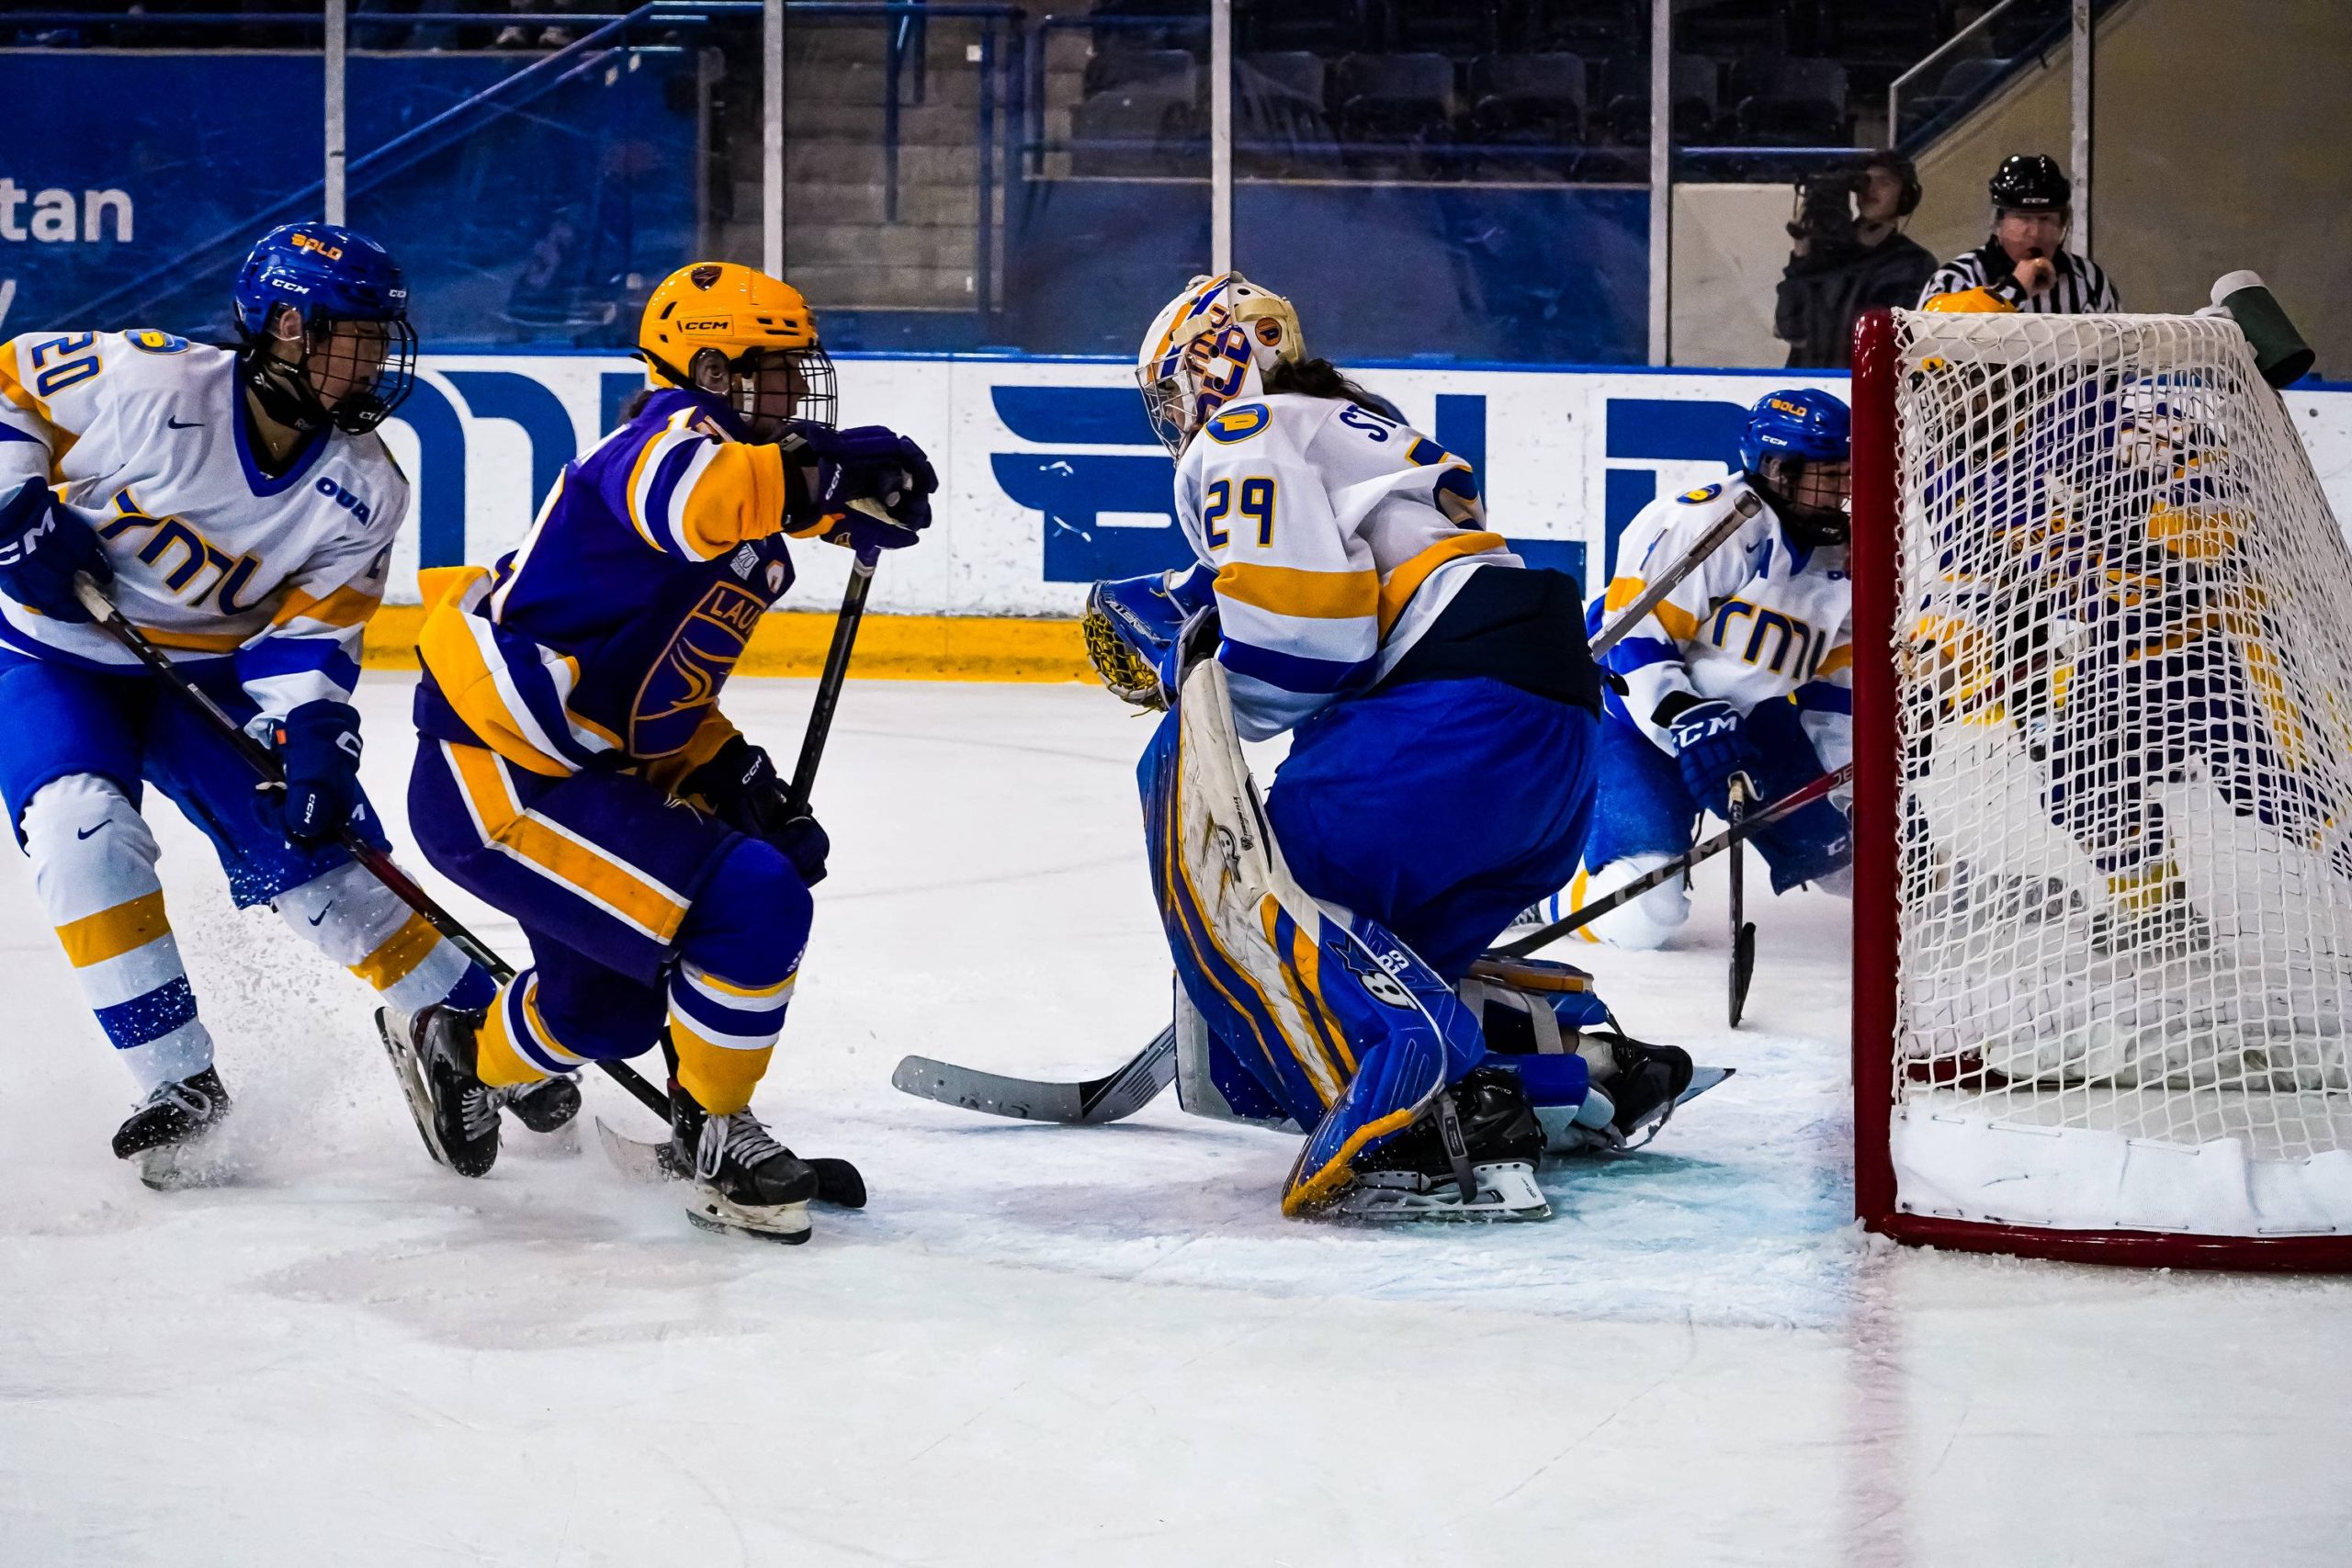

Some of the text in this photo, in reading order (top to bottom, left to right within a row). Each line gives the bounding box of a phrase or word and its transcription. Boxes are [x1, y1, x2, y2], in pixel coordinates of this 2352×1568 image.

[291, 233, 344, 262] BOLD
[272, 278, 311, 295] CCM
[683, 321, 729, 331] CCM
[30, 331, 104, 399] 20
[1770, 399, 1807, 417] BOLD
[1761, 434, 1788, 446] CCM
[315, 476, 371, 526] OUA
[1204, 477, 1277, 550] 29
[742, 756, 763, 784] CCM
[303, 793, 316, 824] CCM
